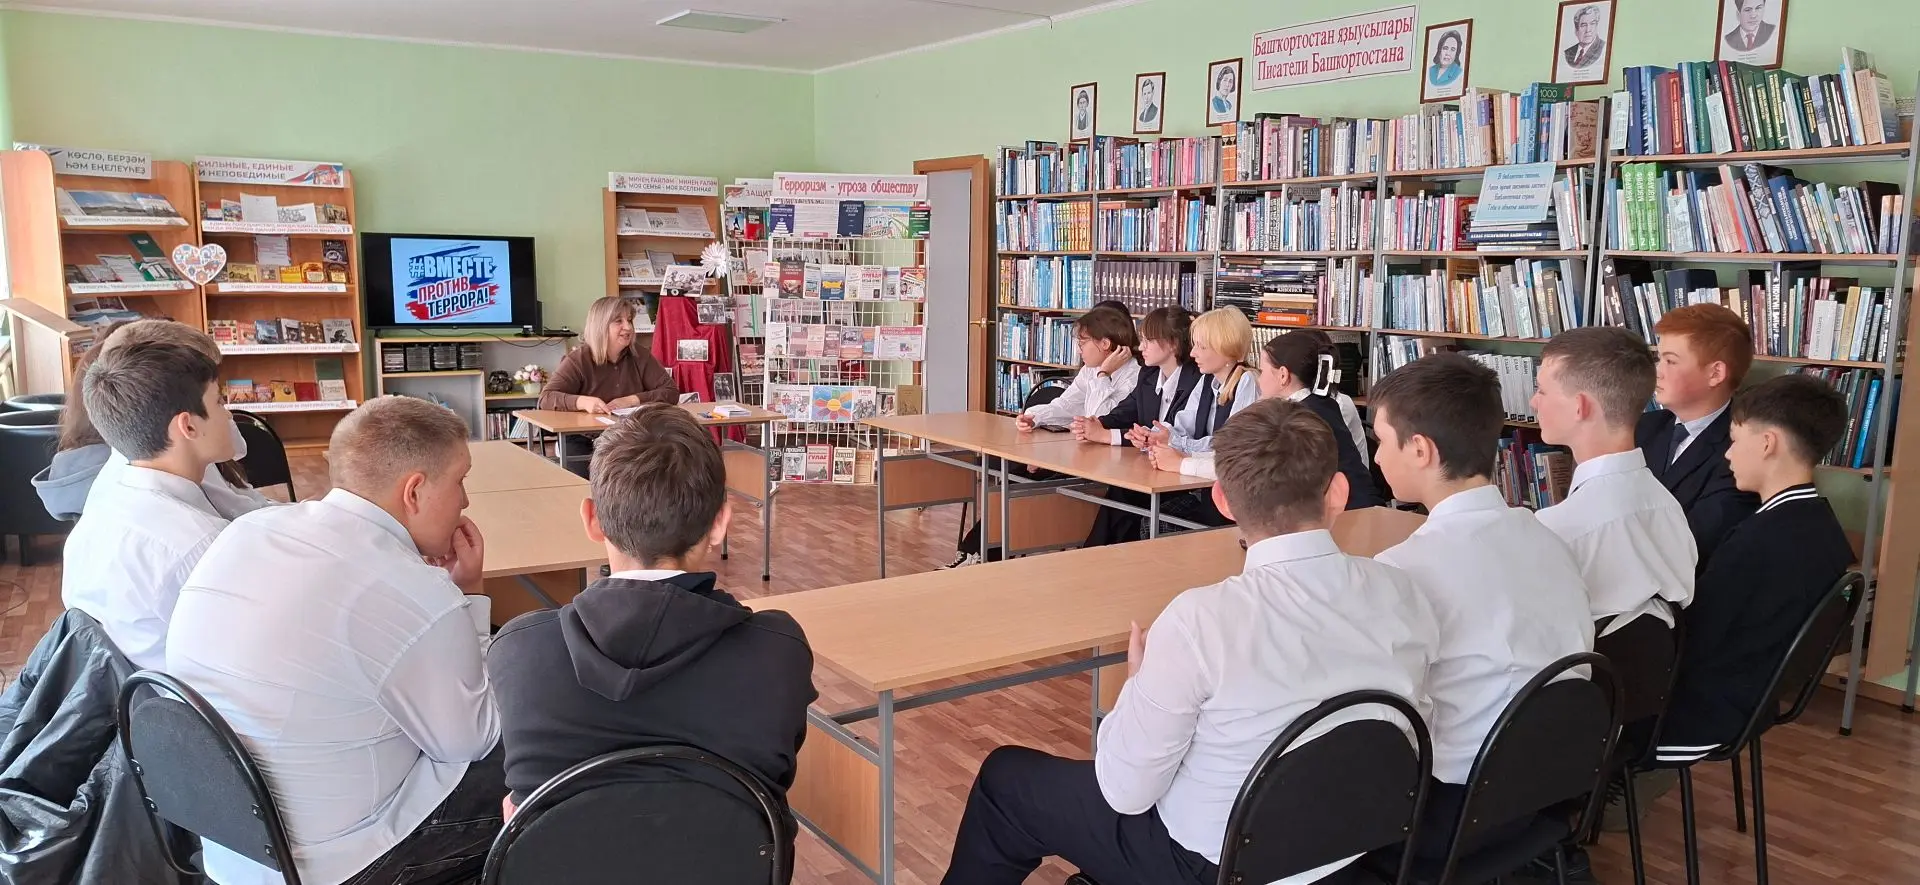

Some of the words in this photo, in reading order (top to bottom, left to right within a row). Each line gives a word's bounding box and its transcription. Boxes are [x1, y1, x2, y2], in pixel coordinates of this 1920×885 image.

[1337, 16, 1414, 46] яҙыусылары
[1257, 59, 1308, 81] Писатели
[1311, 46, 1405, 74] Башкортостана
[197, 160, 250, 170] СИЛЬНЫЕ,
[252, 163, 295, 172] ЕДИНЫЕ
[208, 170, 286, 180] НЕПОБЕДИМЫЕ
[778, 176, 827, 195] Терроризм
[837, 180, 867, 195] угроза
[870, 179, 919, 197] обществу
[408, 255, 494, 279] #ВМЕСТЕ
[418, 276, 470, 303] ПРОТИВ
[427, 286, 490, 317] ТЕРРОРА!
